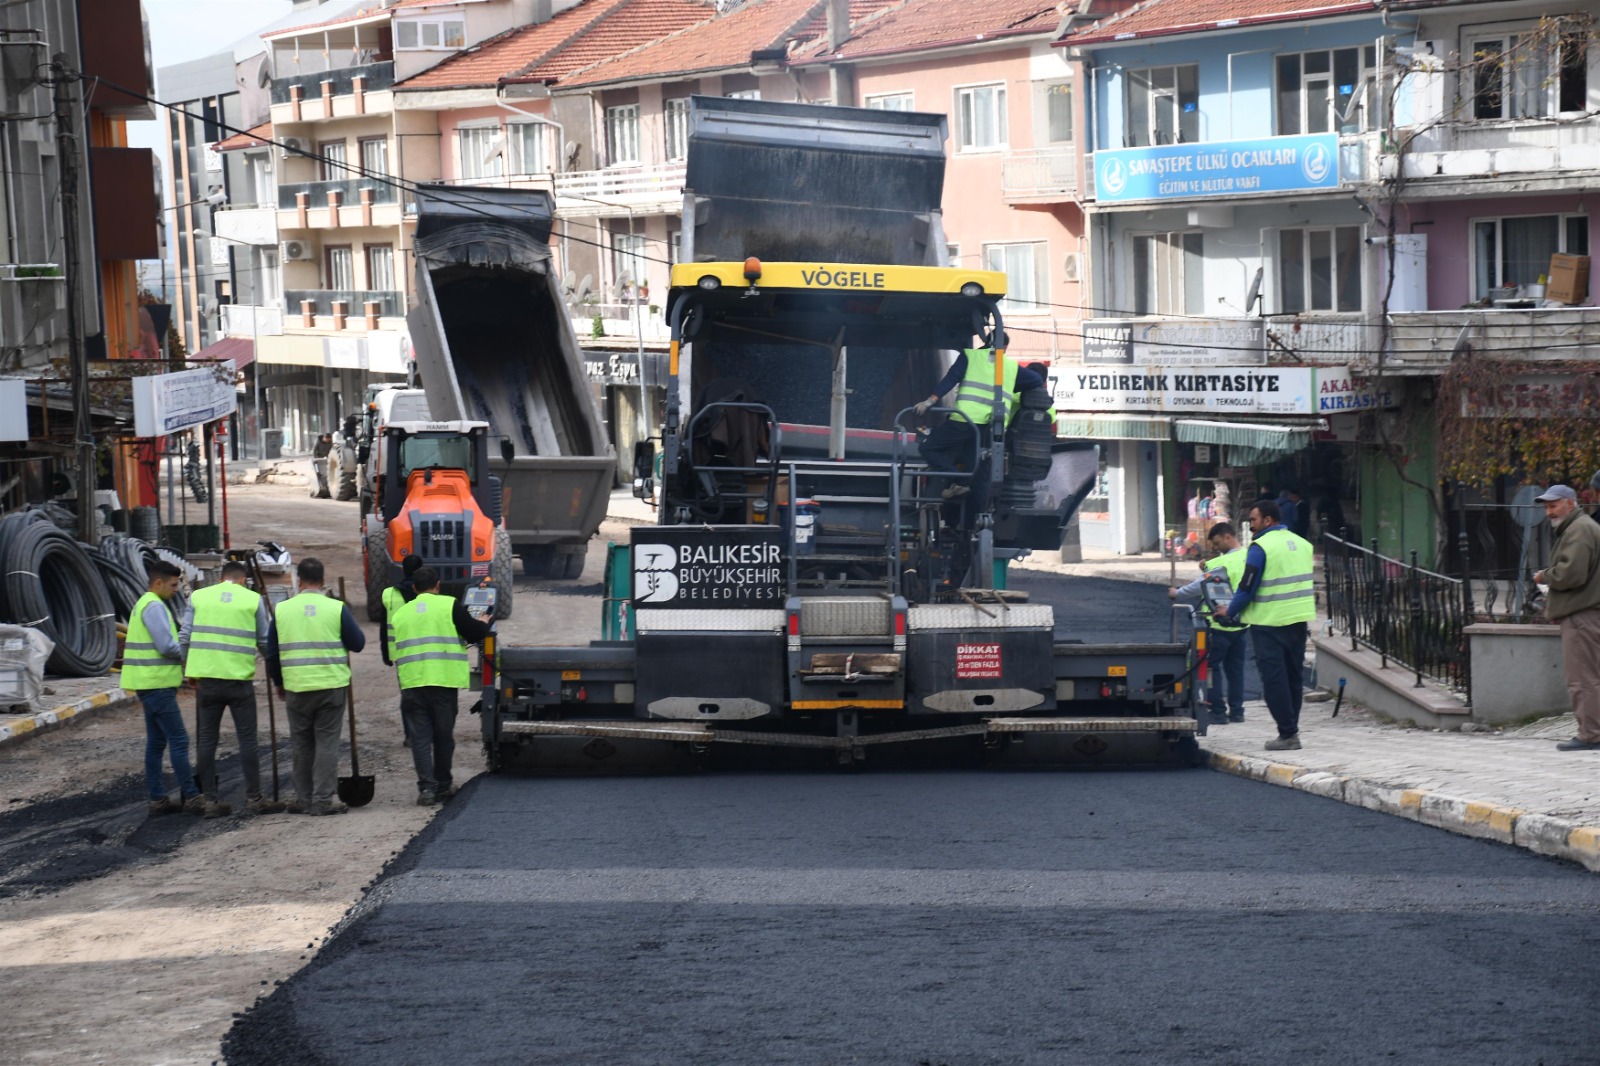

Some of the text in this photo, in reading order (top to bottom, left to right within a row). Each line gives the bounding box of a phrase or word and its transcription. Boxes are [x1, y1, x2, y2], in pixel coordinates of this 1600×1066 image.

[1129, 147, 1297, 178] SAVAŞTEPE ÜLKÜ OCAKLARI
[1189, 179, 1200, 193] VE
[1201, 176, 1234, 192] KÜLTÜR
[1085, 327, 1131, 345] AVUKAT
[1077, 370, 1280, 392] YEDİRENK KIRTASİYE
[1173, 397, 1206, 406] OYUNCAK
[430, 533, 455, 542] HAMM
[679, 541, 781, 564] BALIKESİR
[679, 565, 781, 587] BÜYÜKŞEHİR
[679, 586, 781, 599] BELEDİYESİ
[957, 644, 1000, 654] DİKKAT
